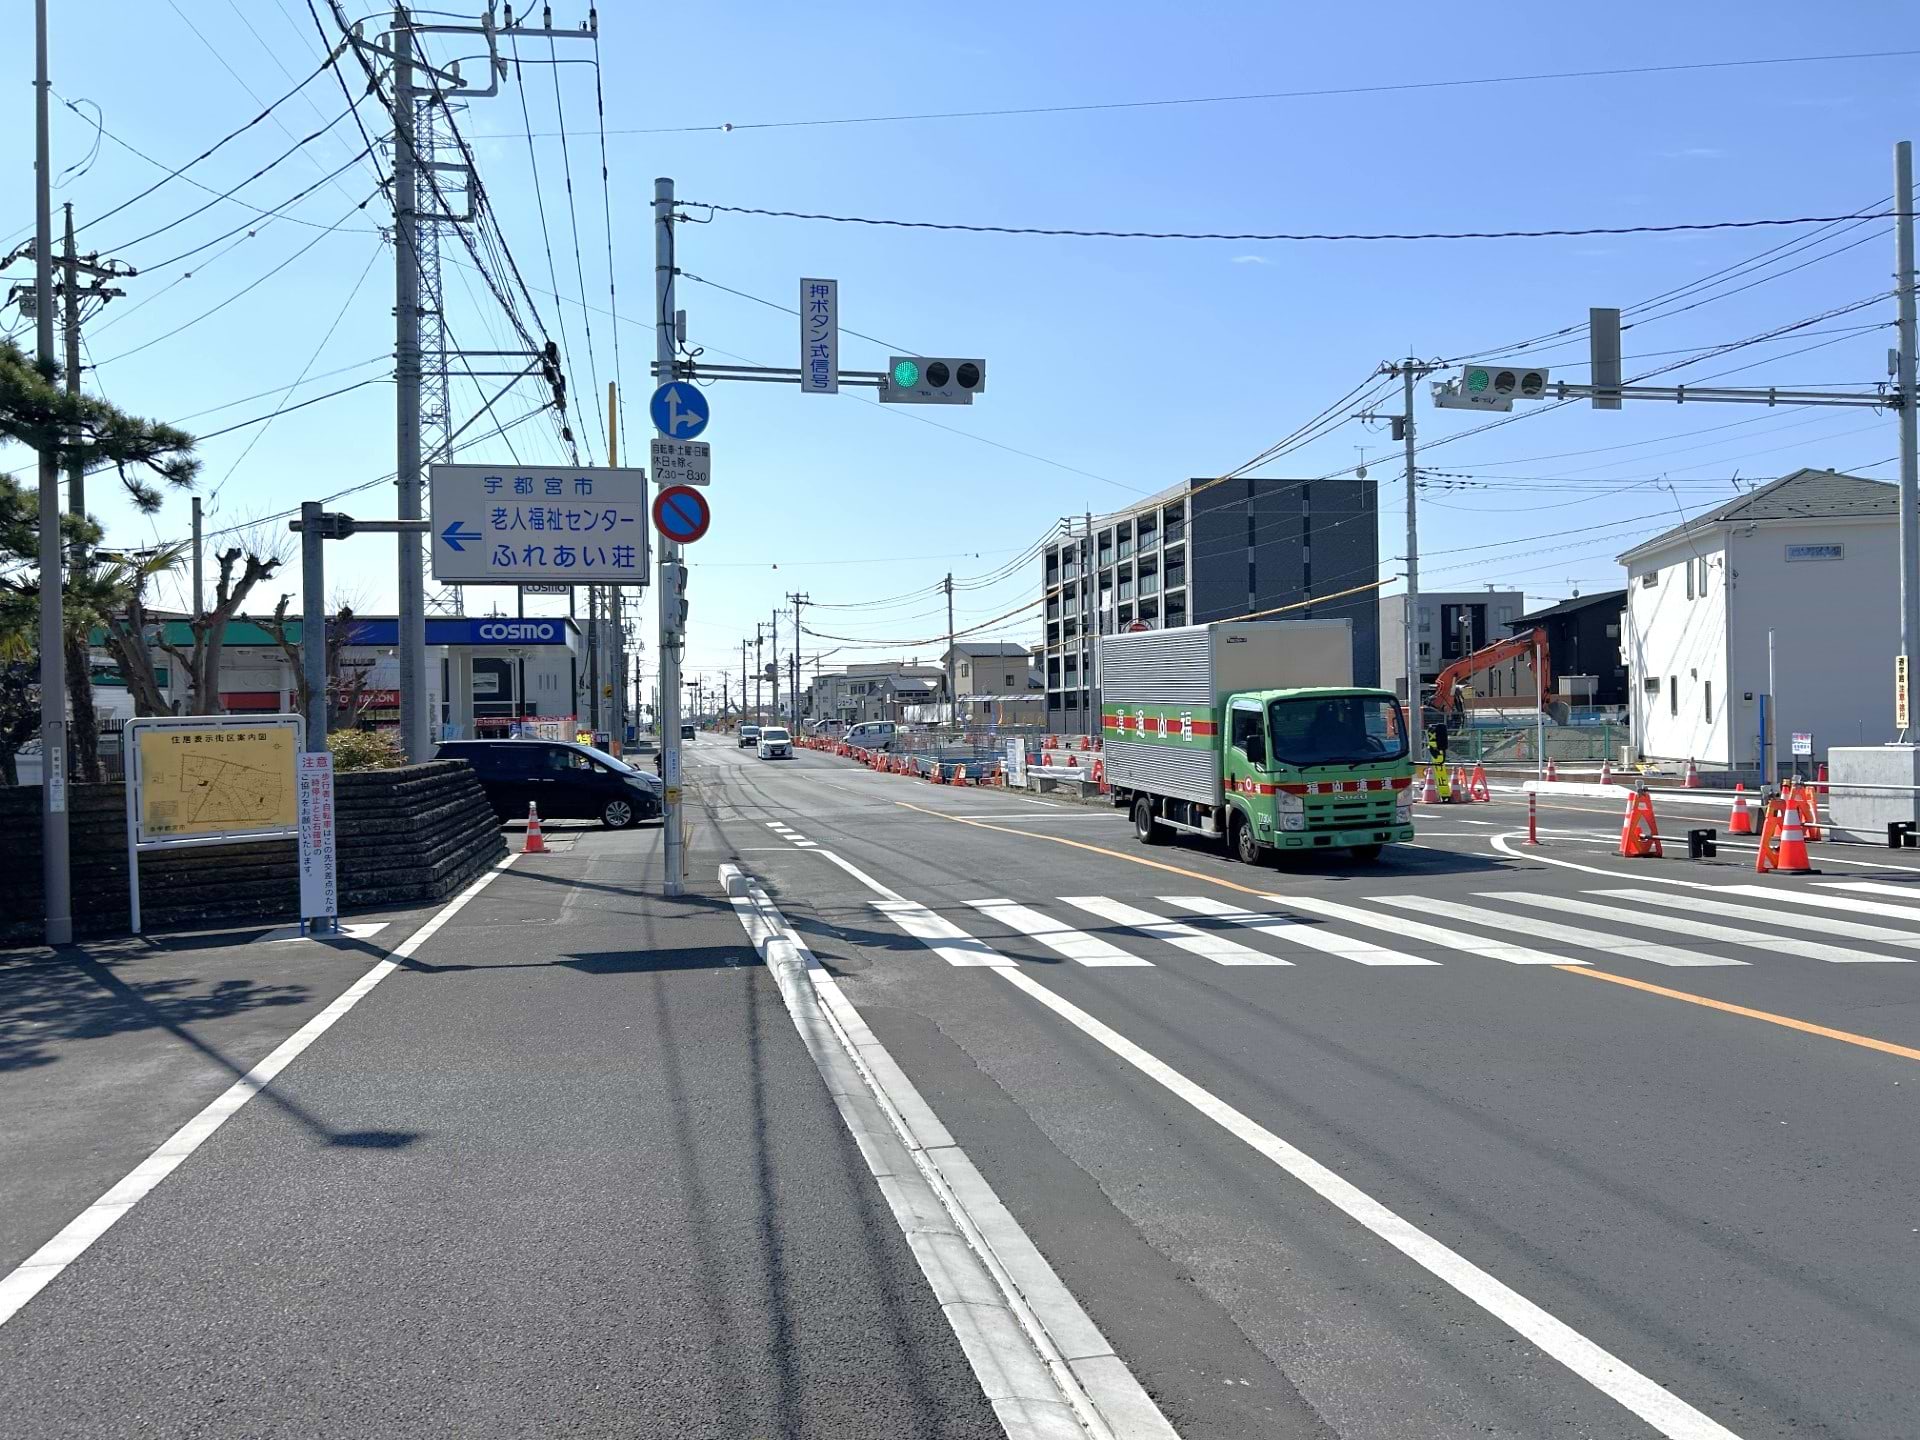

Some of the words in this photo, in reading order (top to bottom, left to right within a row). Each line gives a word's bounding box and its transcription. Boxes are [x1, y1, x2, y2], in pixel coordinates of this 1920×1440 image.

[809, 283, 830, 389] 押ボタン式信号
[653, 456, 693, 468] 休日を除く
[483, 476, 594, 496] 宇都宮市
[490, 506, 635, 531] 老人福祉センター
[492, 544, 636, 569] ふれあい荘
[479, 623, 554, 640] COSMO
[171, 732, 267, 744] 住居表示街区案内図
[302, 756, 328, 768] 注意
